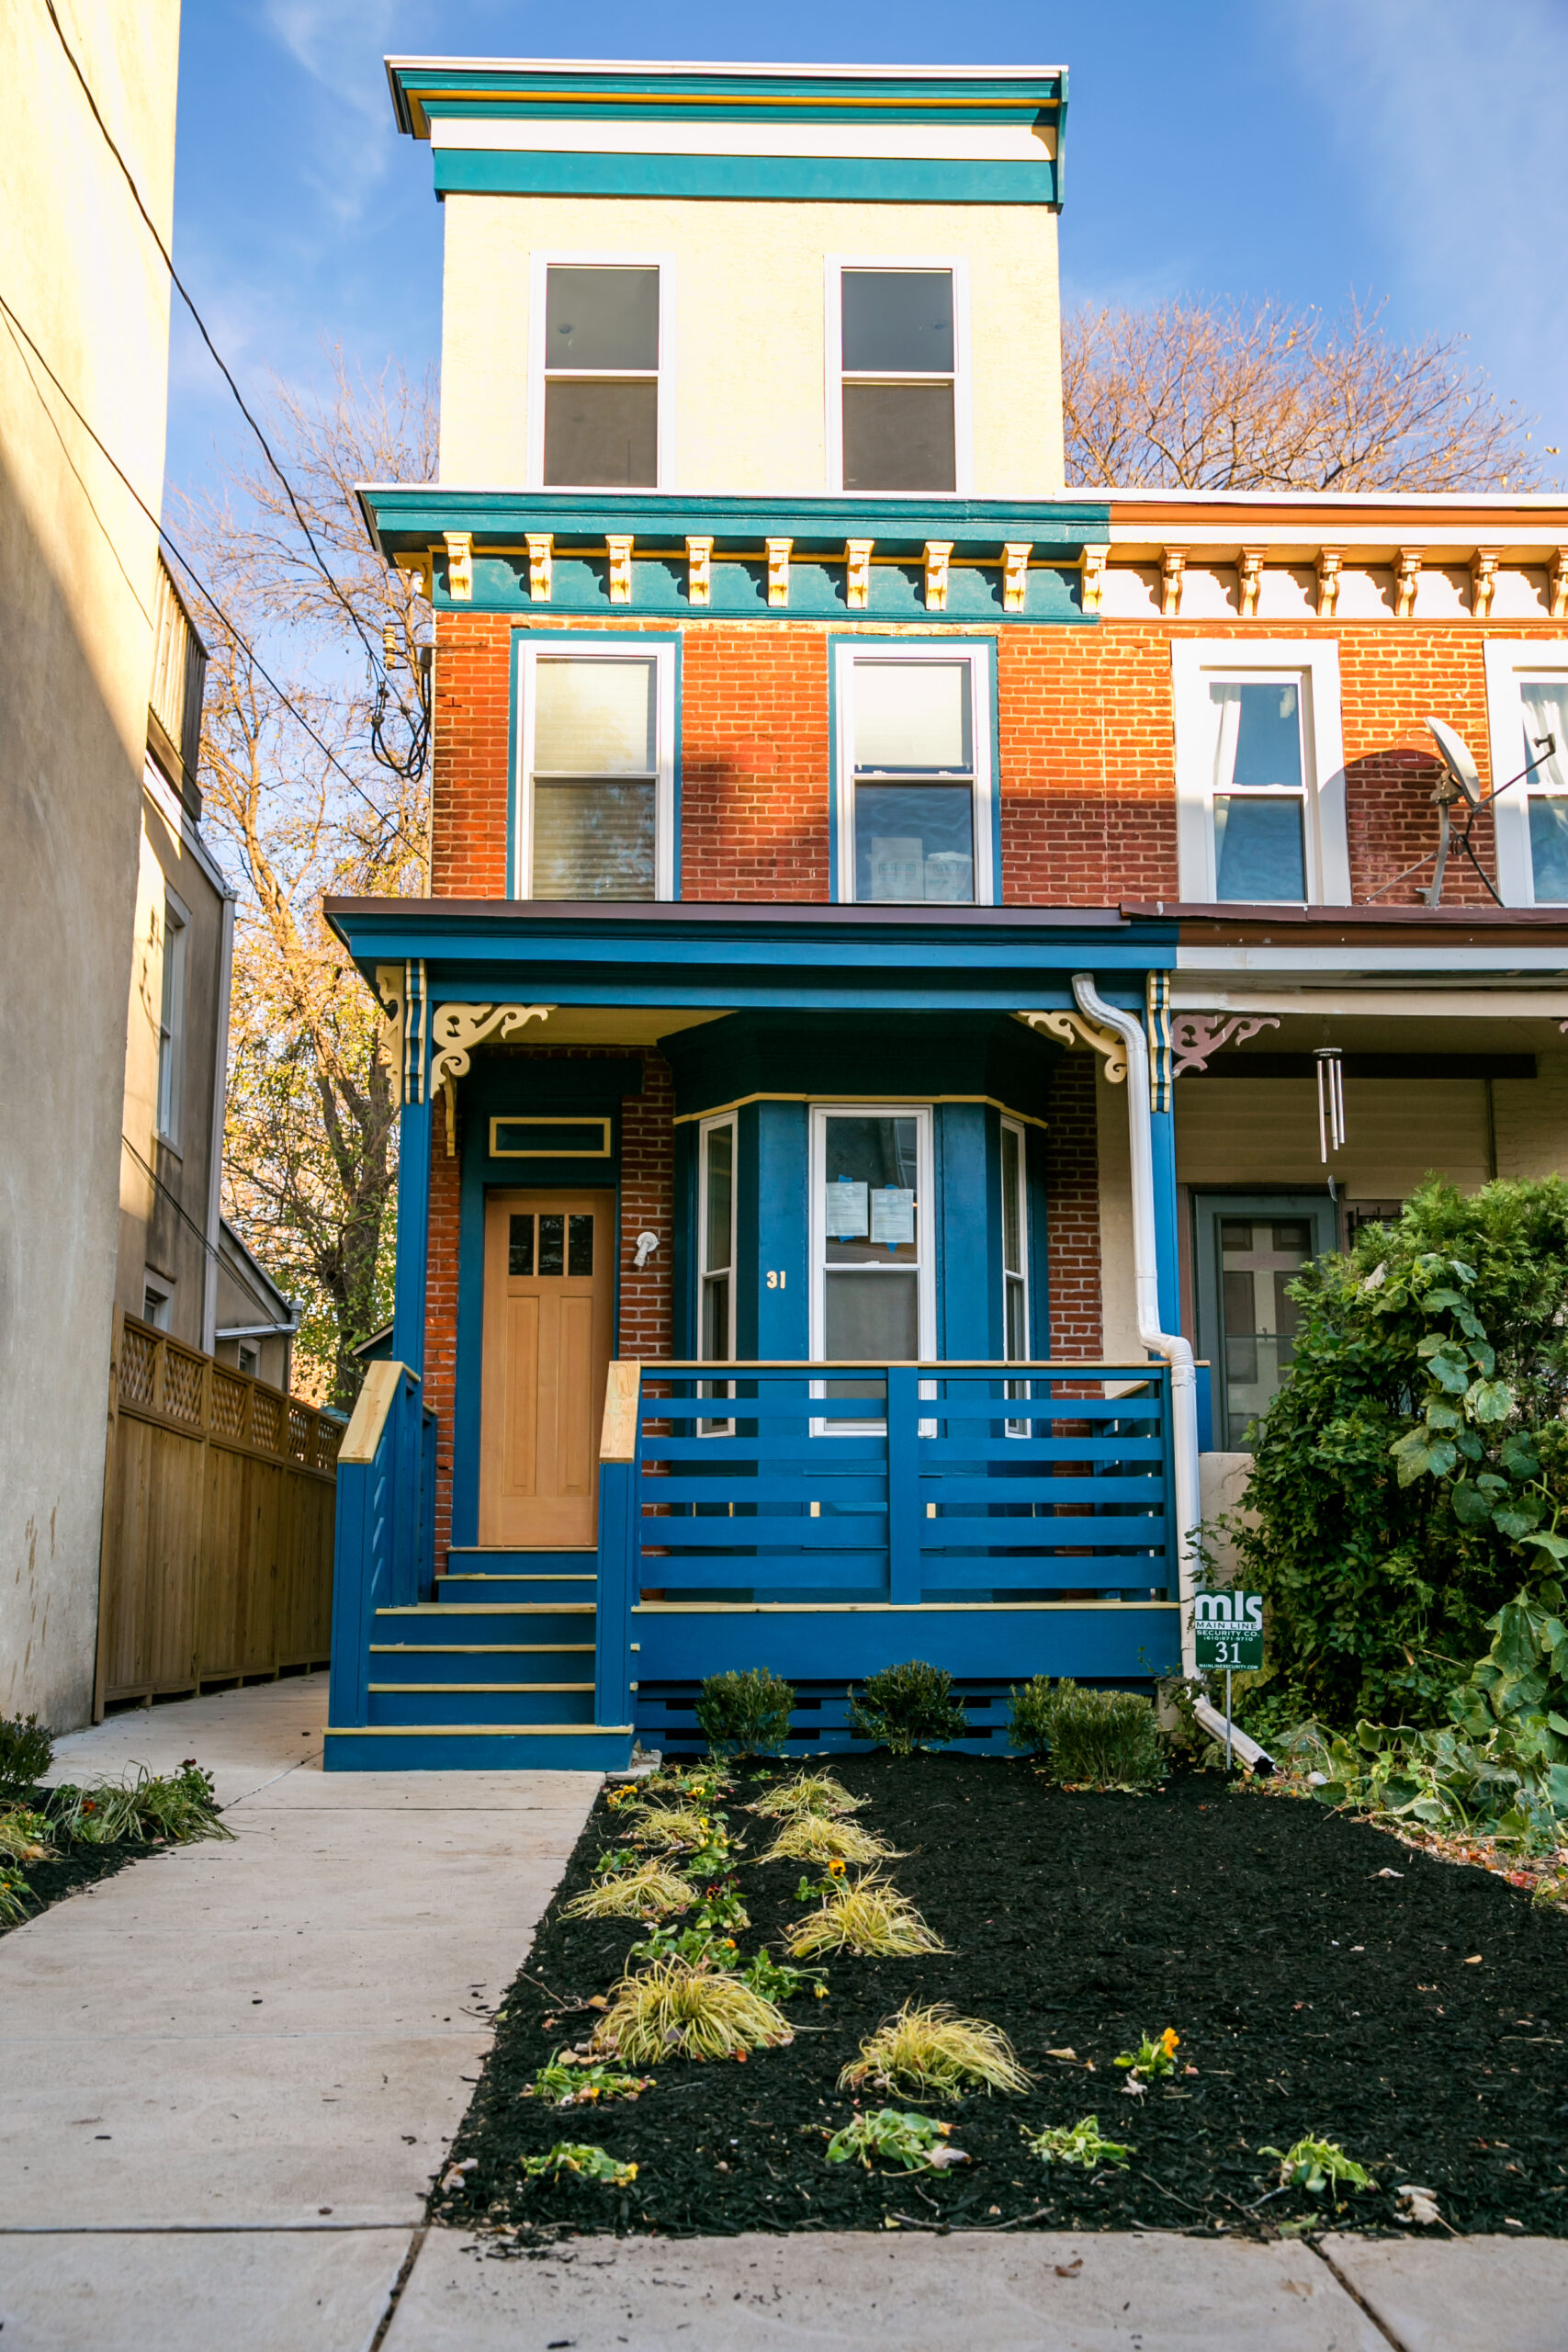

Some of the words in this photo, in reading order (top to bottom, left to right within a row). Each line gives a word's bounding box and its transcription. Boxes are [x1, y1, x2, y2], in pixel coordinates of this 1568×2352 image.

[766, 1271, 786, 1289] 31
[1195, 1590, 1262, 1623] mls
[1214, 1641, 1241, 1664] 31
